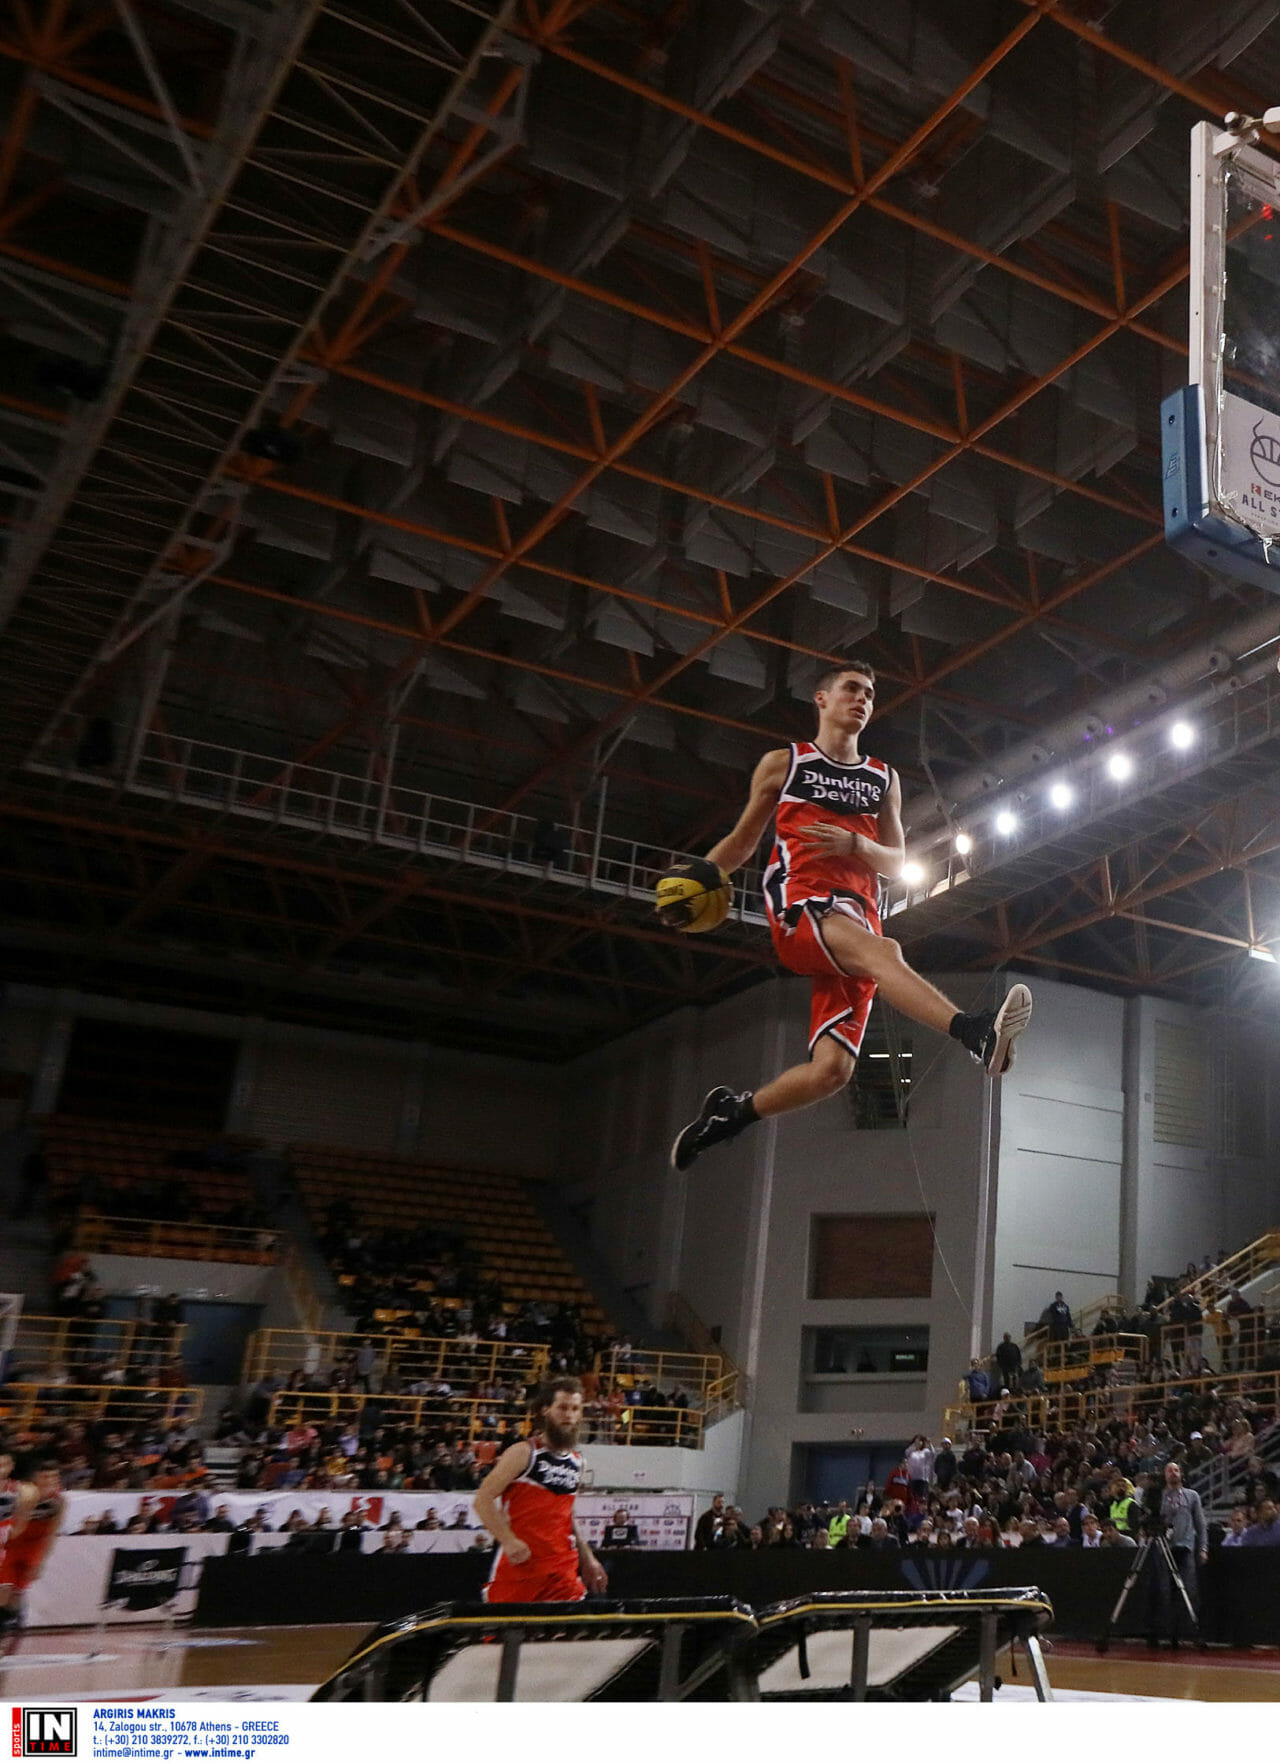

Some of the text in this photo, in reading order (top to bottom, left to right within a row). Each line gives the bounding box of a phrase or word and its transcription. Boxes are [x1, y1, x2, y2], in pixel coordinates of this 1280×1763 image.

[1242, 494, 1265, 513] ALL
[802, 769, 881, 802] Dunking
[811, 784, 869, 807] Devils
